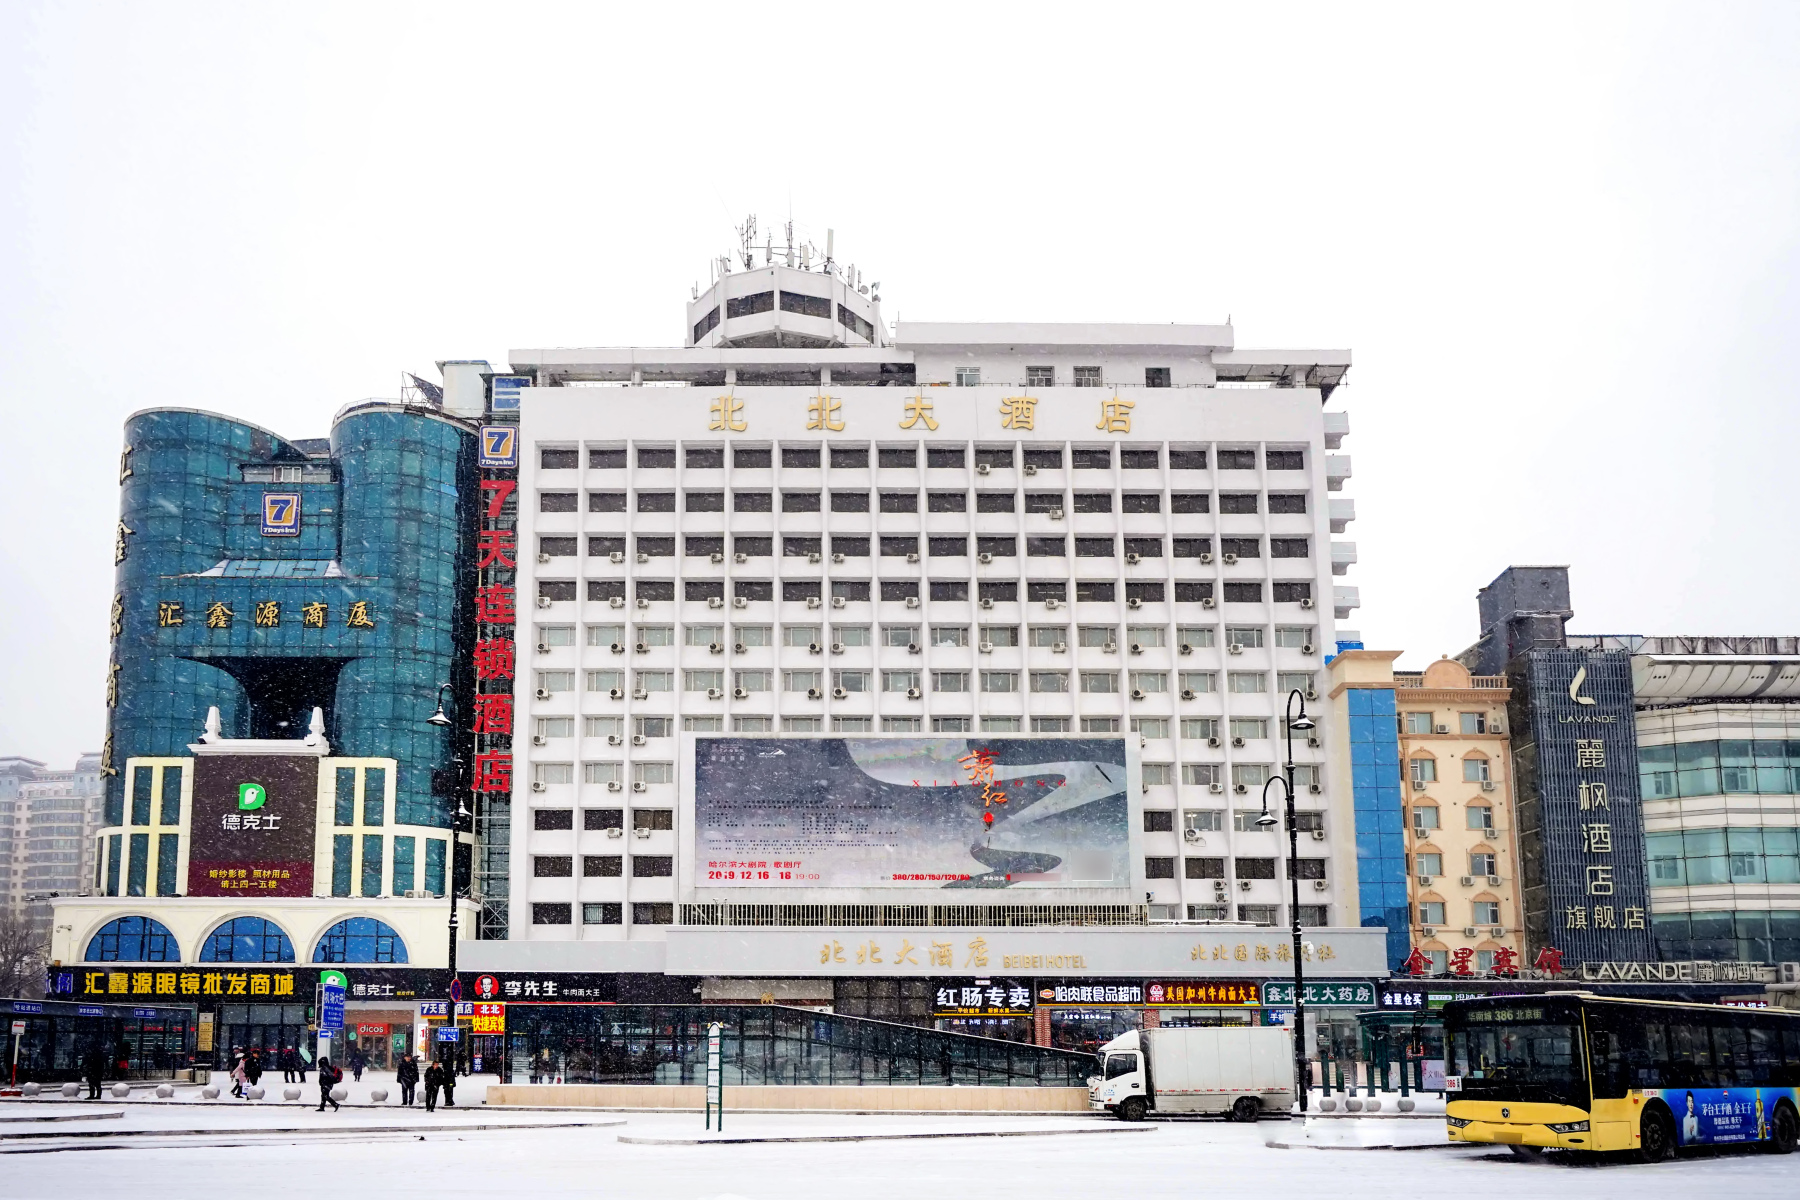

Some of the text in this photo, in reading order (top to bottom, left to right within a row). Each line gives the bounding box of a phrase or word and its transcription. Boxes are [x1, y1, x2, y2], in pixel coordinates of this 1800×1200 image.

[709, 395, 1136, 434] 北北大酒店
[487, 431, 510, 454] 7
[269, 499, 293, 522] 7
[159, 601, 374, 629] 汇鑫源商厦
[471, 480, 517, 792] 7天连锁酒店
[1559, 714, 1617, 723] LAVANDE
[222, 813, 282, 831] 德克士
[209, 869, 247, 879] 婚纱影楼
[1566, 905, 1645, 931] 旗舰店
[820, 936, 991, 968] 北北大酒店
[1003, 954, 1088, 969] BEIBEI HOTEL
[1404, 946, 1564, 976] 金星宾馆
[1582, 961, 1692, 981] LAVANDE
[84, 972, 294, 995] 汇鑫源眼镜批发商城
[353, 984, 395, 996] 德克士
[504, 981, 558, 996] 李先生
[562, 988, 600, 997] 牛肉面大王
[936, 986, 1031, 1007] 红肠专卖
[1055, 986, 1141, 1002] 哈肉联食品超市
[1166, 986, 1258, 1001] 美国加州牛肉面大王
[1267, 986, 1371, 1002] 鑫北北大药房
[1384, 993, 1422, 1006] 金星仓买
[421, 1003, 474, 1015] 7天连酒店
[480, 1004, 500, 1015] 北北
[1468, 1008, 1543, 1022] 华南城 386 北京街
[359, 1025, 384, 1034] dicos
[1446, 1079, 1456, 1088] 386
[1701, 1101, 1752, 1116] 茅台王子酒 金王子
